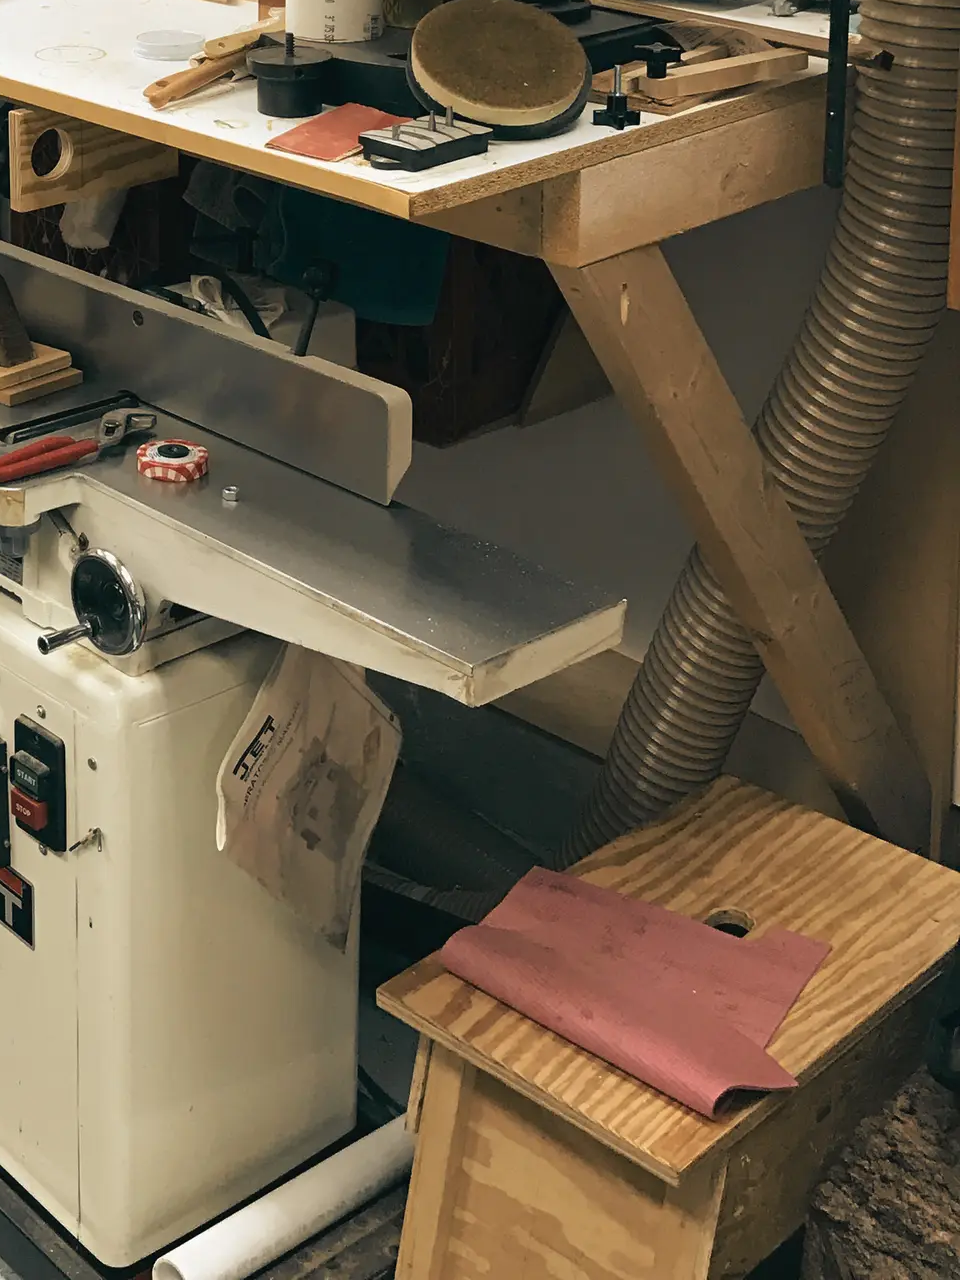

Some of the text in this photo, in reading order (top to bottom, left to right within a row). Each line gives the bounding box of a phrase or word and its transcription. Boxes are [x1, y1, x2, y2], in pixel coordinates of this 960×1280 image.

[239, 718, 276, 781] JET
[16, 769, 36, 786] START
[15, 803, 31, 817] STOP
